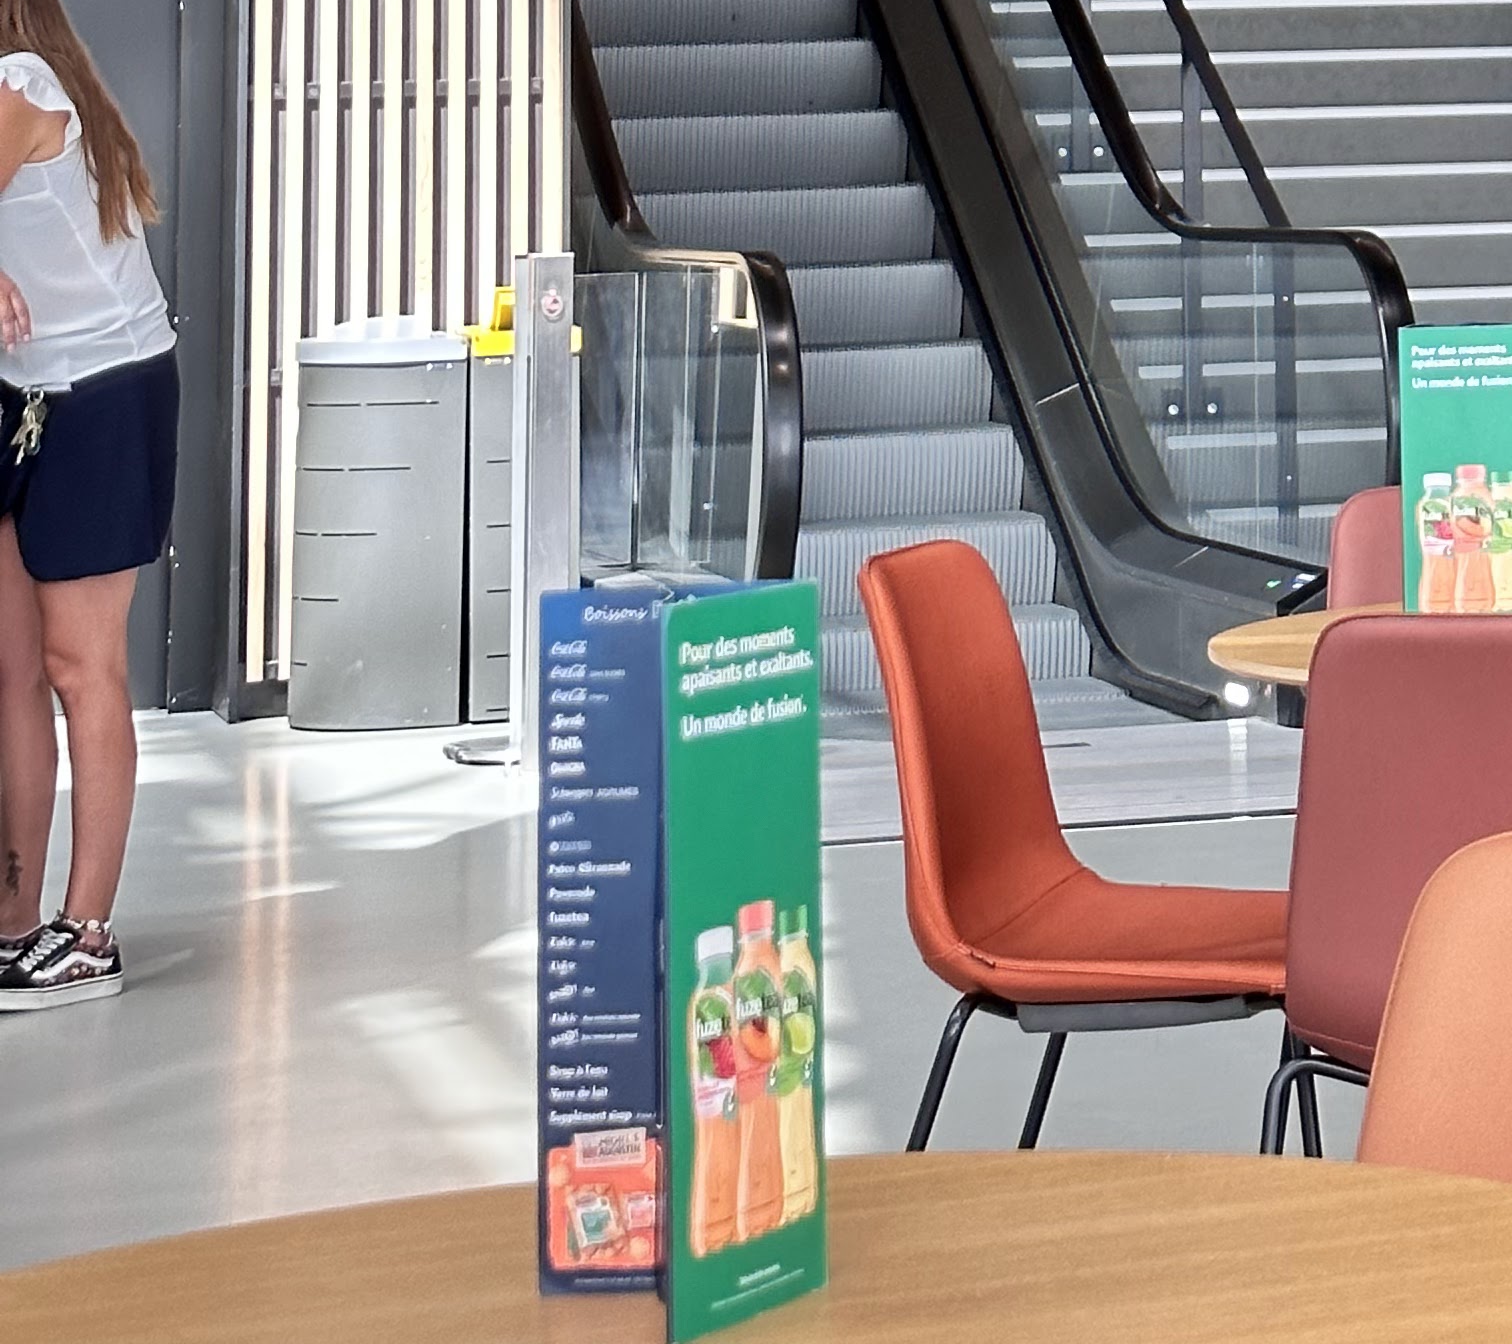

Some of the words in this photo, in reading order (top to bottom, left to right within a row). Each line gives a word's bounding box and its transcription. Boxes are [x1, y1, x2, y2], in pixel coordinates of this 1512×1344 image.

[583, 604, 649, 622] Boissons
[682, 642, 712, 664] Pour
[715, 635, 738, 657] des
[740, 625, 795, 653] moments
[681, 665, 742, 696] apaisants
[744, 658, 759, 679] et
[759, 648, 814, 676] exaltants.
[682, 714, 702, 737] Un
[704, 705, 748, 732] monde
[750, 701, 765, 723] de
